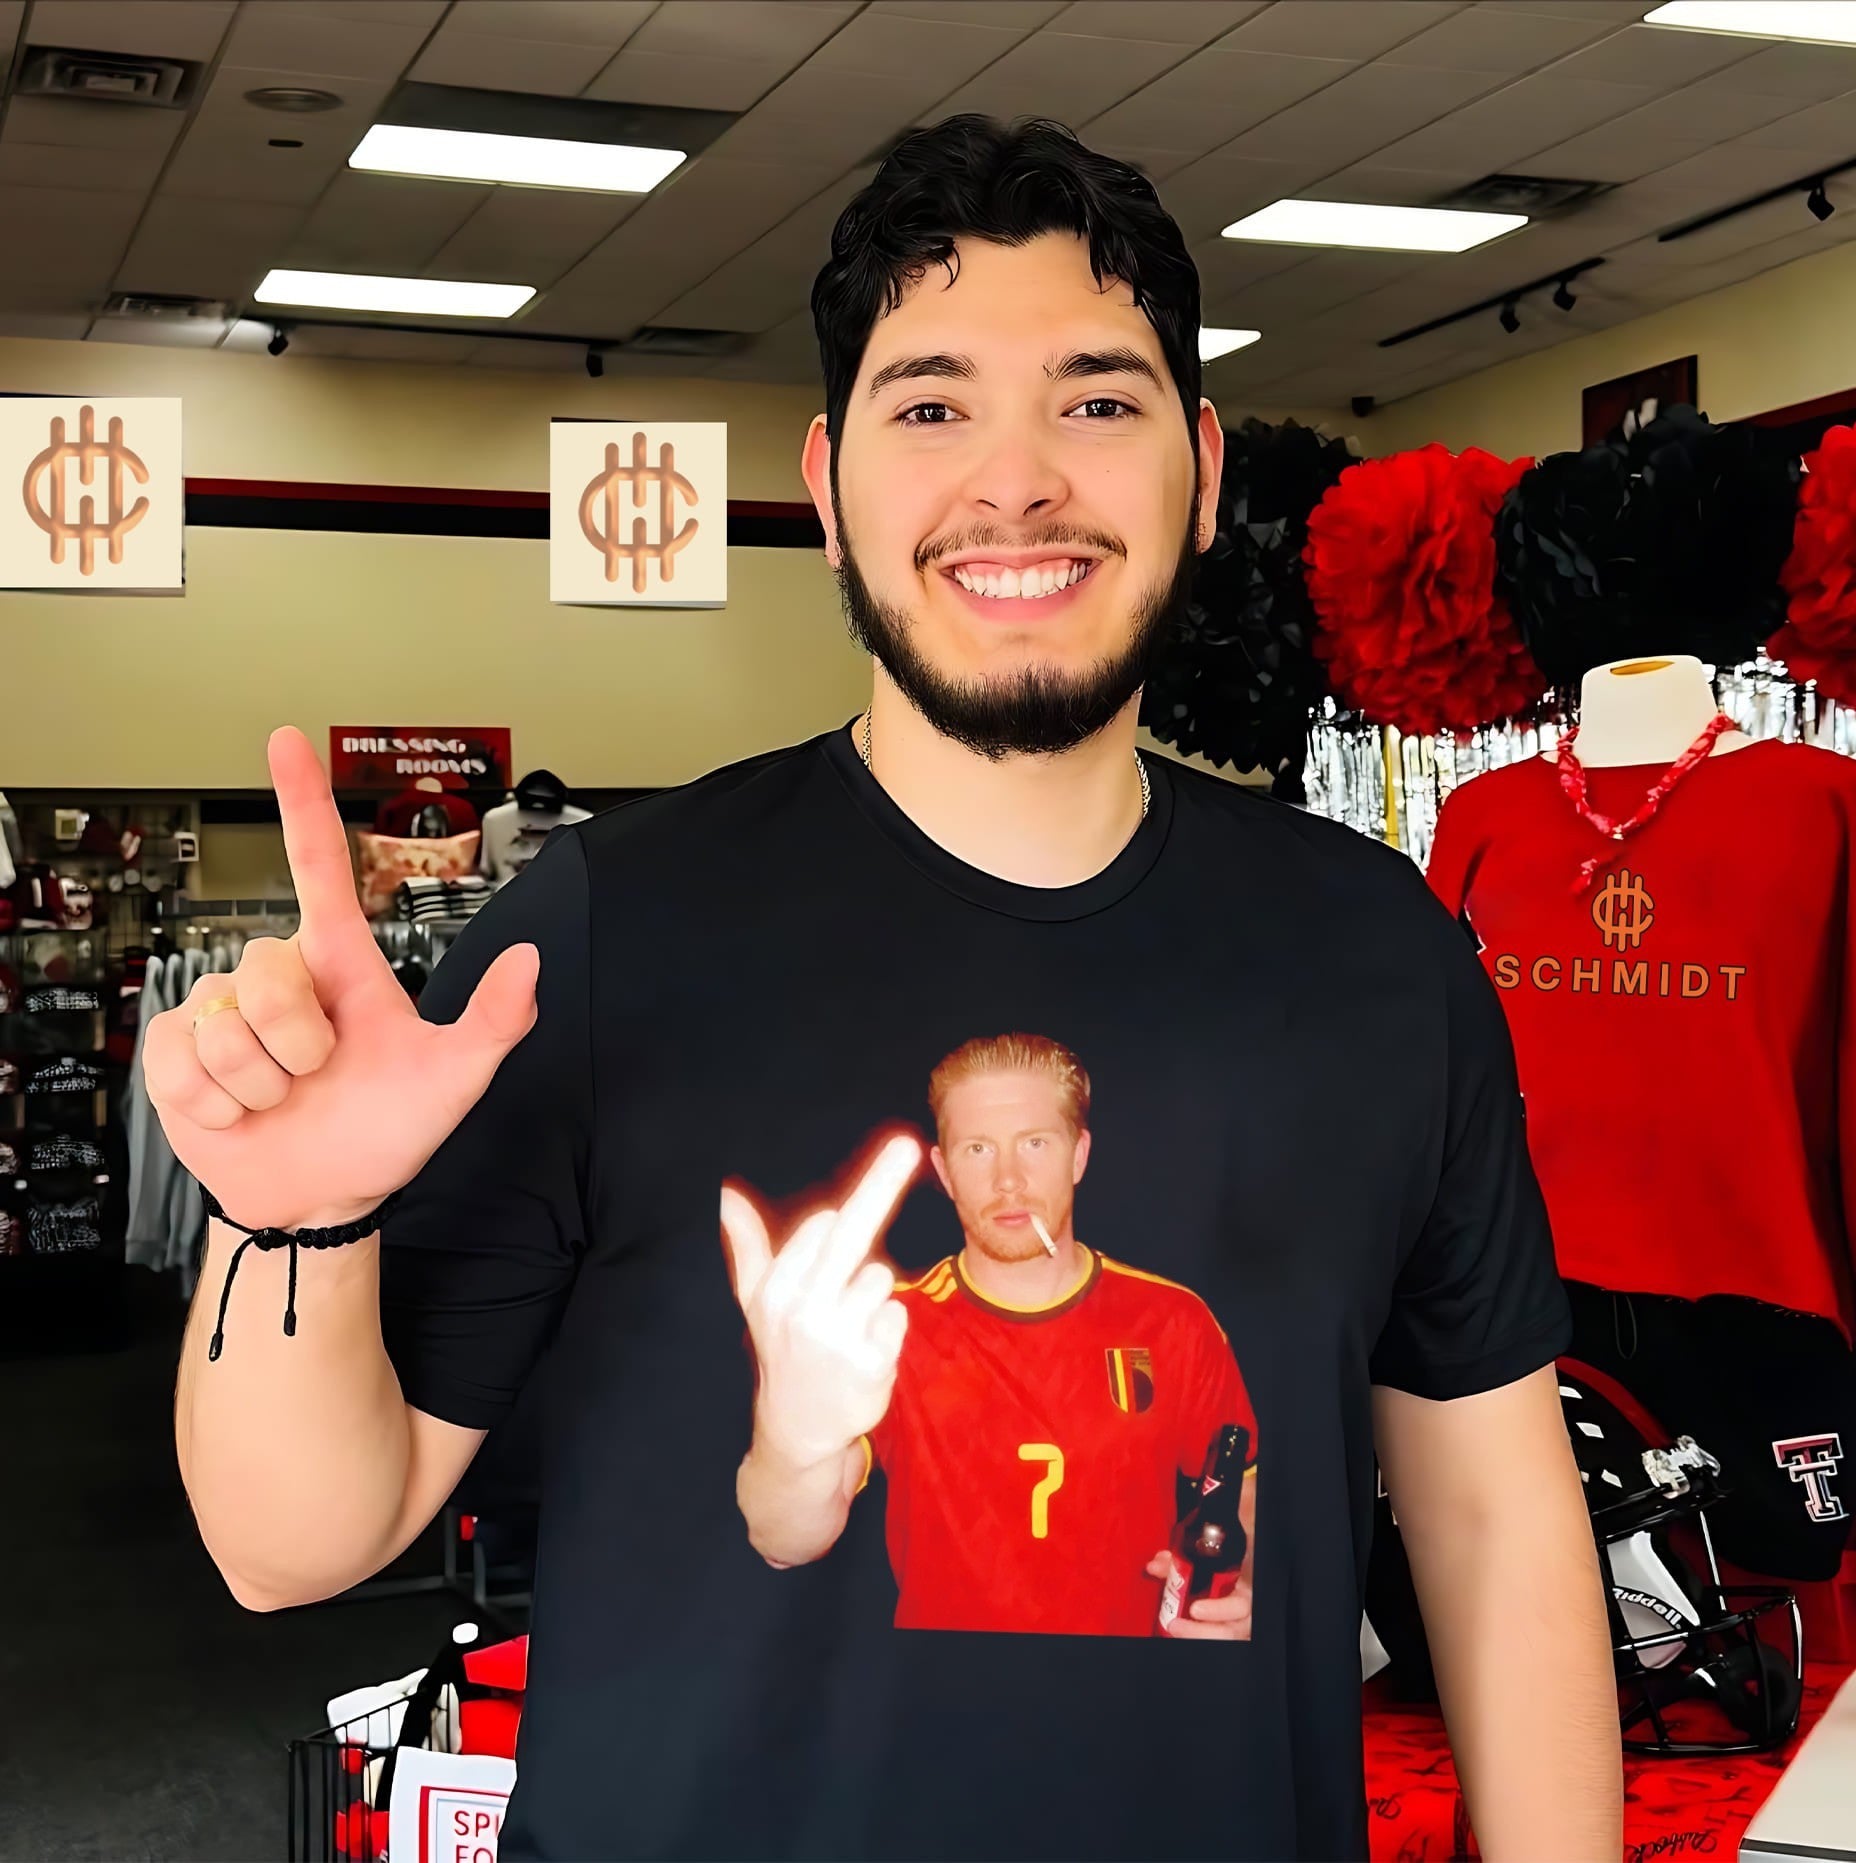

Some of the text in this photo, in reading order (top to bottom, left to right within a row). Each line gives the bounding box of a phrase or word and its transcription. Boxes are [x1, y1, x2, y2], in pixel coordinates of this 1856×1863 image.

[342, 737, 467, 753] DRESSING
[396, 758, 487, 775] ROOMS
[1494, 953, 1747, 1000] SCHMIDT
[1018, 1443, 1065, 1539] 7
